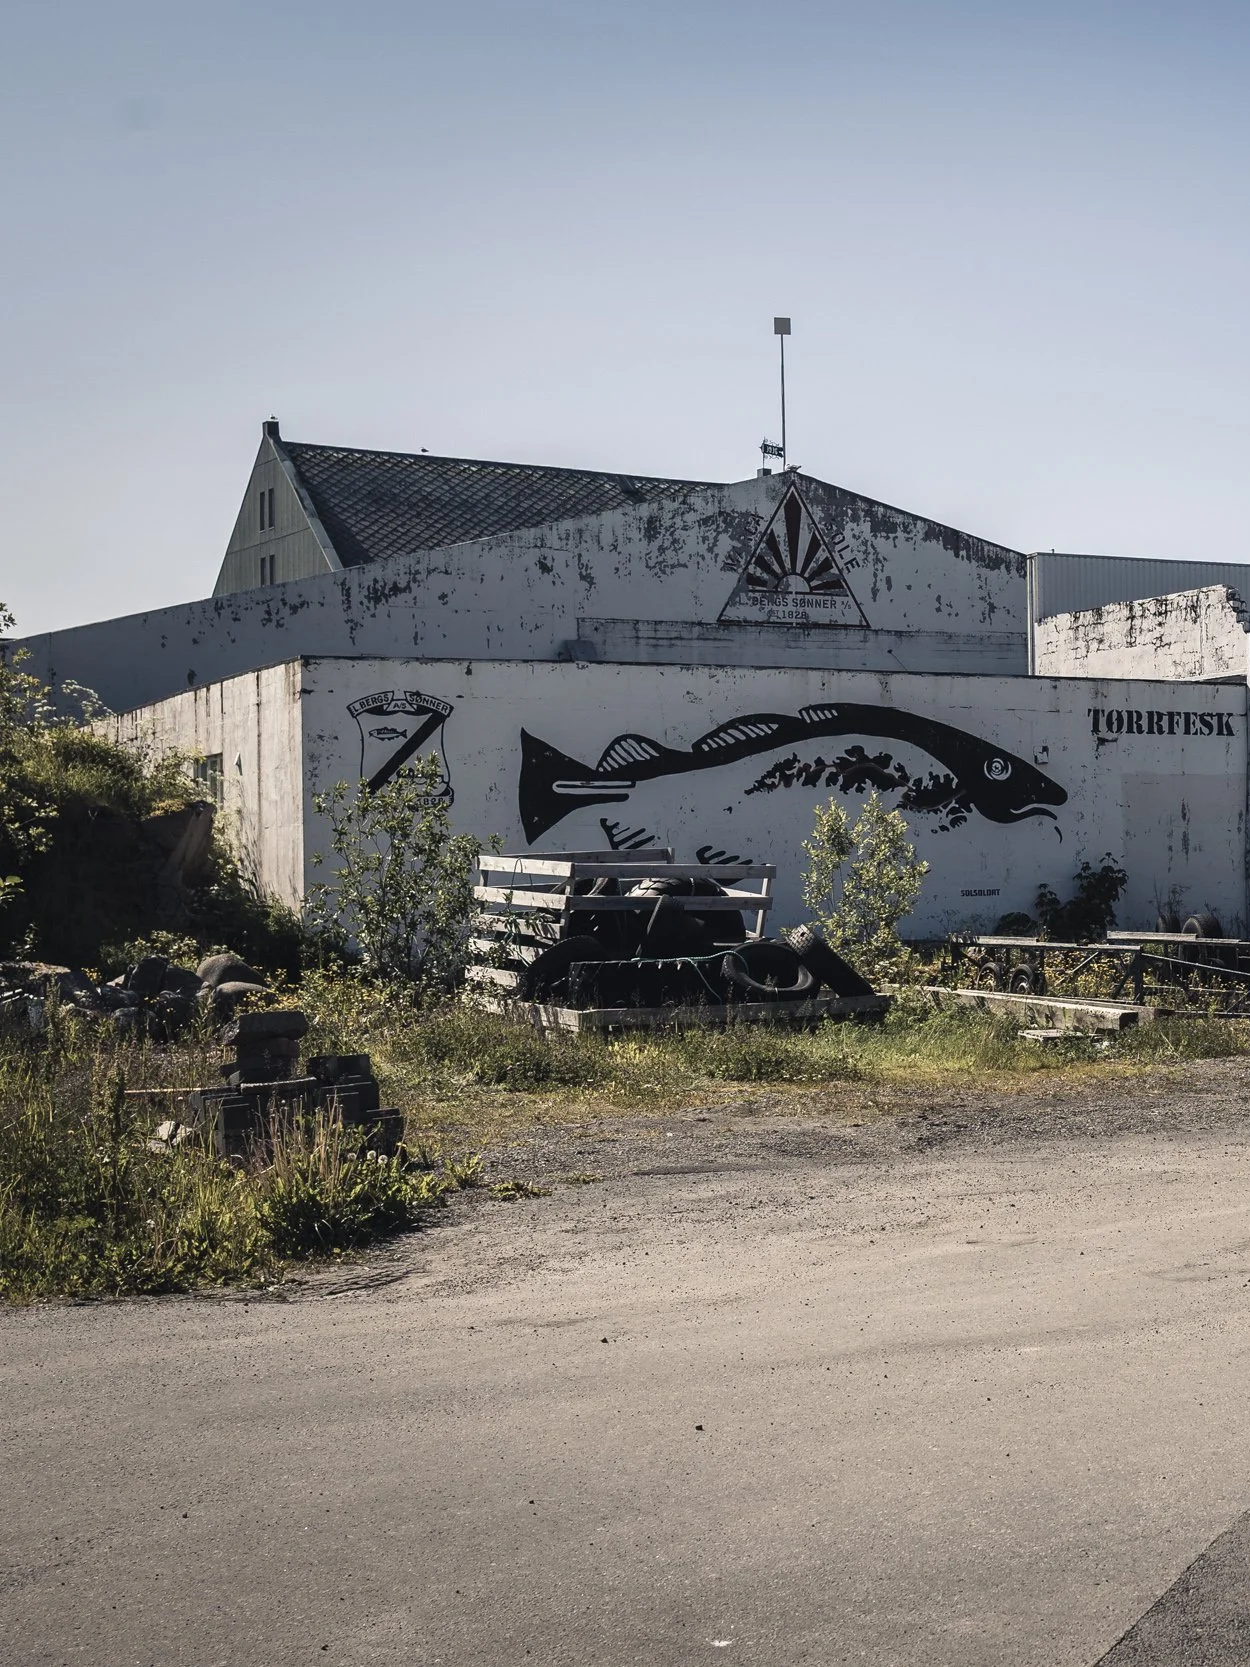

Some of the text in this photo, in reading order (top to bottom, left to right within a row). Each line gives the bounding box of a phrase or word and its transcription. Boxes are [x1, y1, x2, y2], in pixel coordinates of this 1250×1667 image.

[791, 598, 837, 609] SØNNER
[781, 610, 807, 619] 1828
[408, 692, 449, 714] SØNNER
[1087, 708, 1236, 737] TØRRFESK
[960, 888, 1001, 897] SOLSOLDAT
